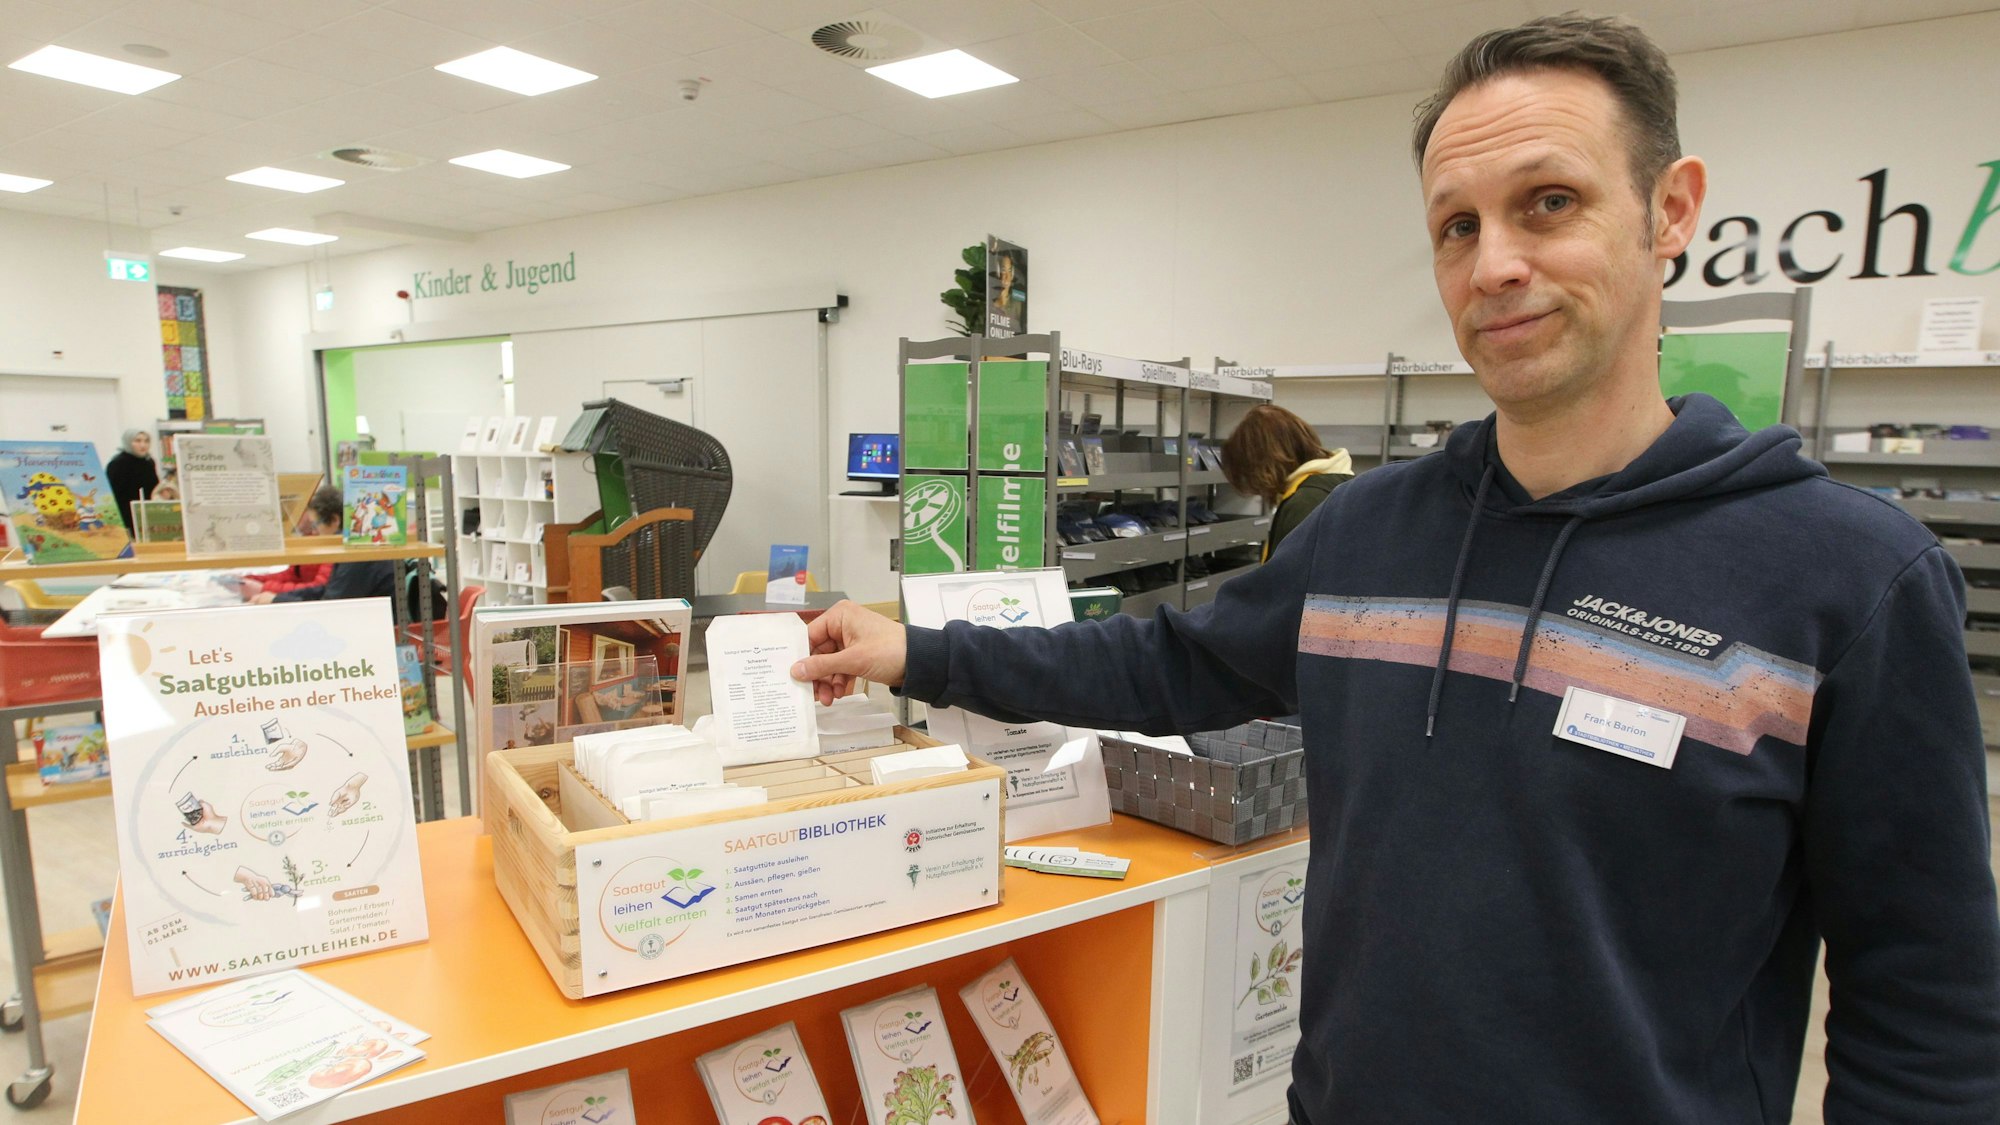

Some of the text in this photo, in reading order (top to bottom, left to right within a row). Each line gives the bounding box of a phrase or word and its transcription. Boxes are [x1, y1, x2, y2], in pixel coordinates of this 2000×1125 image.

[414, 251, 576, 299] Kinder & Jugend
[990, 313, 1011, 327] FILME
[1062, 350, 1103, 375] Blu-Rays
[1833, 352, 1919, 366] Hörbücher
[1141, 363, 1177, 384] Spielfilme
[1222, 366, 1276, 377] Hörbücher
[1393, 362, 1454, 373] Hörbücher
[1190, 371, 1220, 390] Spielfilme
[188, 453, 224, 461] Frohe
[184, 463, 226, 472] Ostern
[973, 603, 1001, 611] Saatgut
[1573, 594, 1723, 647] JACK&JONES
[189, 647, 233, 666] Let's
[159, 659, 376, 695] Saatgutbibliothek
[194, 684, 398, 717] Ausleihe an der Theke!
[1004, 728, 1027, 736] Tomate
[1584, 713, 1647, 737] Frank Barion
[231, 734, 246, 744] 1.
[209, 743, 269, 760] ausleihen
[249, 797, 285, 808] Saatgut
[362, 801, 377, 811] 2.
[250, 809, 277, 819] leihen
[251, 815, 314, 831] Vielfalt ernten
[925, 827, 946, 835] Initiative
[954, 821, 977, 830] Erhaltung
[176, 829, 193, 844] 4.
[724, 813, 887, 854] SAATGUTBIBLIOTHEK
[925, 832, 953, 842] historischer
[953, 826, 986, 838] Gemüsesorten
[157, 840, 238, 859] zurückgeben
[311, 860, 329, 875] 3.
[733, 860, 776, 874] Saatguttüte
[777, 854, 809, 867] ausleihen
[925, 864, 942, 873] Verein
[951, 858, 975, 868] Erhaltung
[303, 874, 341, 887] ernten
[725, 882, 733, 890] 2.
[797, 865, 821, 877] gießen
[343, 888, 369, 898] SAATEN
[613, 879, 667, 898] Saatgut
[734, 892, 759, 903] Samen
[760, 887, 783, 897] ernten
[1263, 886, 1287, 898] Saatgut
[328, 906, 358, 917] Bohnen
[364, 900, 390, 911] Erbsen
[614, 901, 653, 916] leihen
[735, 903, 763, 915] Saatgut
[764, 896, 801, 909] spätestens
[802, 891, 818, 900] nach
[1262, 900, 1280, 909] leihen
[329, 911, 384, 926] Gartenmelden
[735, 898, 831, 924] neun Monaten zurückgeben
[1262, 910, 1282, 921] Vielfalt
[147, 918, 183, 937] AB DEM
[330, 925, 350, 935] Salat
[357, 919, 390, 929] Tomaten
[614, 908, 707, 935] Vielfalt ernten
[168, 929, 399, 982] WWW.SAATGUTLEIHEN.DE
[879, 1019, 905, 1030] Saatgut
[882, 1031, 902, 1041] leihen
[885, 1033, 931, 1051] Vielfalt ernten
[738, 1058, 765, 1073] Saatgut
[742, 1071, 763, 1083] leihen
[746, 1070, 793, 1094] Vielfalt ernten
[549, 1104, 584, 1117] Saatgut
